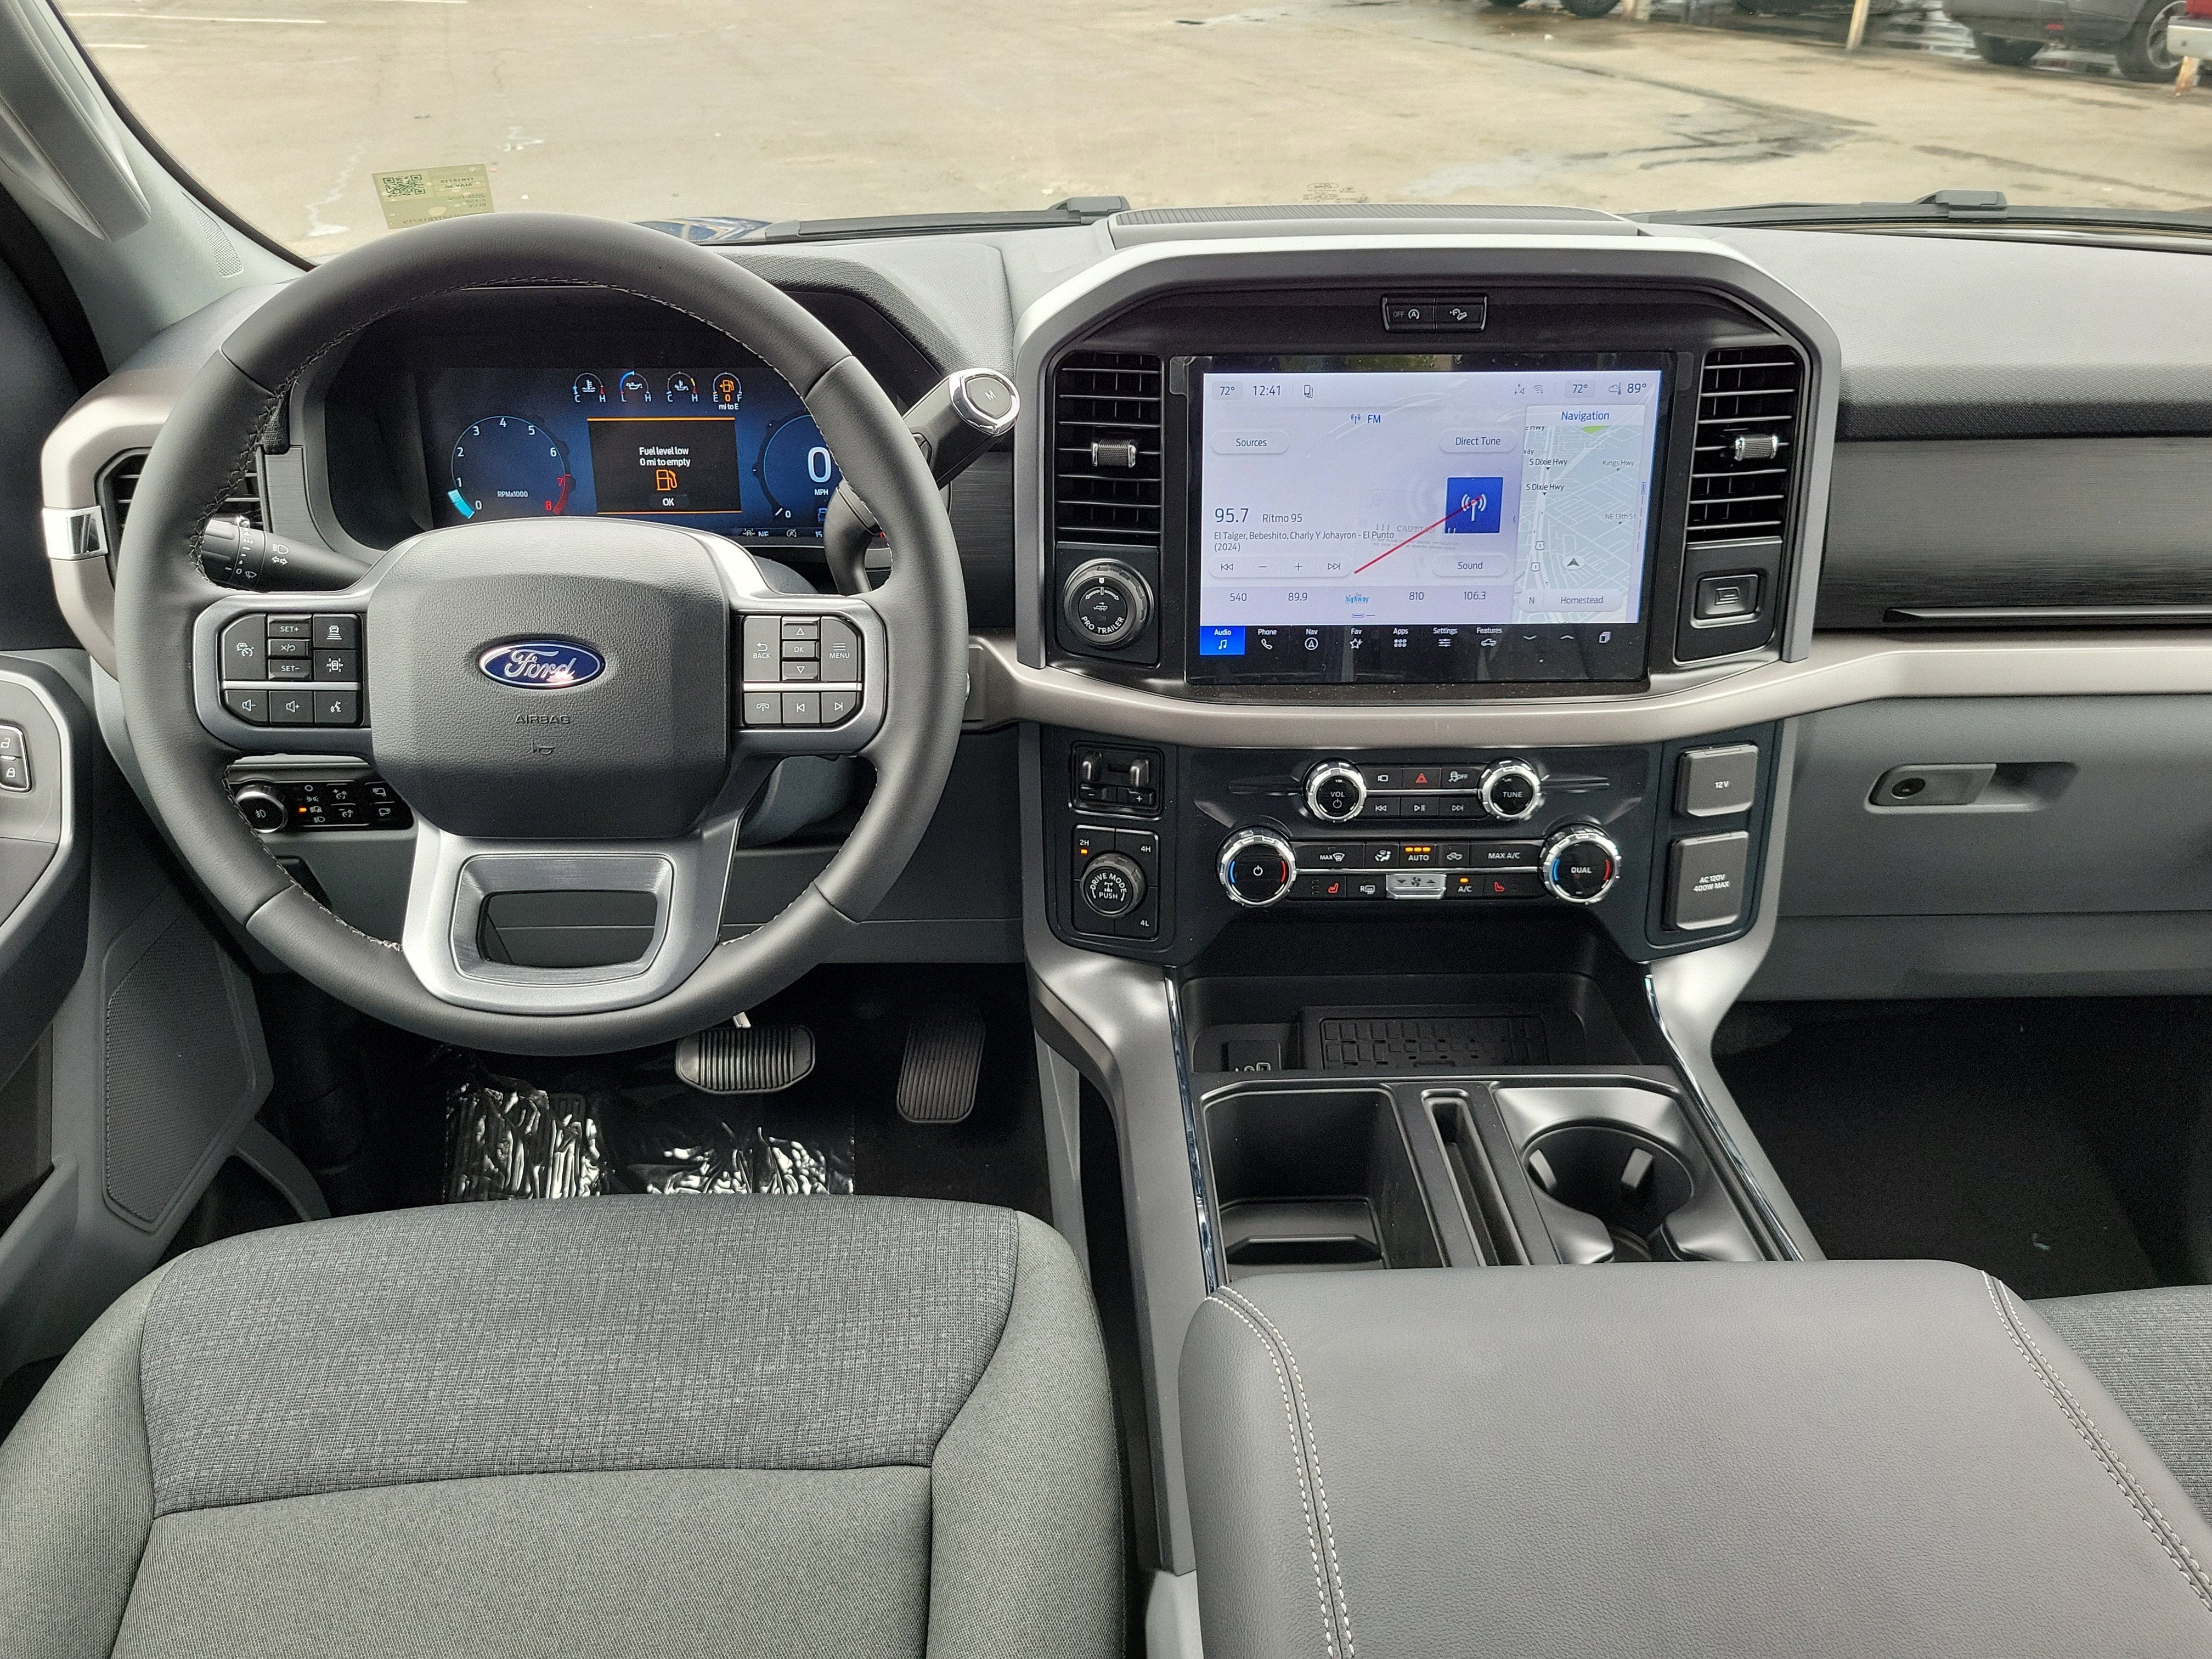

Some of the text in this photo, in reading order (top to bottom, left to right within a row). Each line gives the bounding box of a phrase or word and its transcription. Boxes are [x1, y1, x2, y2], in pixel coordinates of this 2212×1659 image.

[984, 390, 997, 401] M
[1252, 385, 1281, 396] 12:41
[574, 394, 580, 403] C
[599, 394, 606, 403] H
[1368, 414, 1381, 424] FM
[1561, 411, 1610, 421] Navigation
[499, 417, 507, 427] 4
[472, 426, 480, 436] 3
[528, 425, 535, 436] 5
[1235, 438, 1267, 447] Sources
[1455, 437, 1500, 445] Direct Tune
[456, 447, 464, 457] 2
[550, 447, 557, 457] 6
[639, 447, 689, 455] Fuel level low
[667, 459, 691, 467] empty
[808, 447, 832, 483] 0
[456, 477, 462, 487] 1
[556, 477, 563, 487] 7
[475, 500, 482, 510] 0
[545, 500, 552, 511] 8
[662, 498, 675, 506] OK
[785, 510, 791, 518] 0
[1215, 507, 1302, 523] 95.7 Ritmo 95
[1223, 532, 1248, 540] Taiger,
[1249, 531, 1289, 540] Bebeshito,
[1290, 531, 1314, 540] Charly
[1322, 531, 1356, 540] Johayron
[1372, 531, 1394, 539] Punto
[1214, 543, 1241, 552] (2024)
[1458, 561, 1483, 569] Sound
[1229, 592, 1307, 601] 540 89.9
[1409, 591, 1486, 600] 810 106.3
[1081, 615, 1125, 634] PRO TRAILER
[504, 648, 577, 682] Ford
[515, 714, 571, 724] AIRBAG
[1090, 872, 1127, 894] DRIVE MODE
[1709, 874, 1726, 882] 120V
[1458, 885, 1472, 893] A/C
[1693, 881, 1730, 892] 400W MAX
[1099, 891, 1118, 900] PUSH
